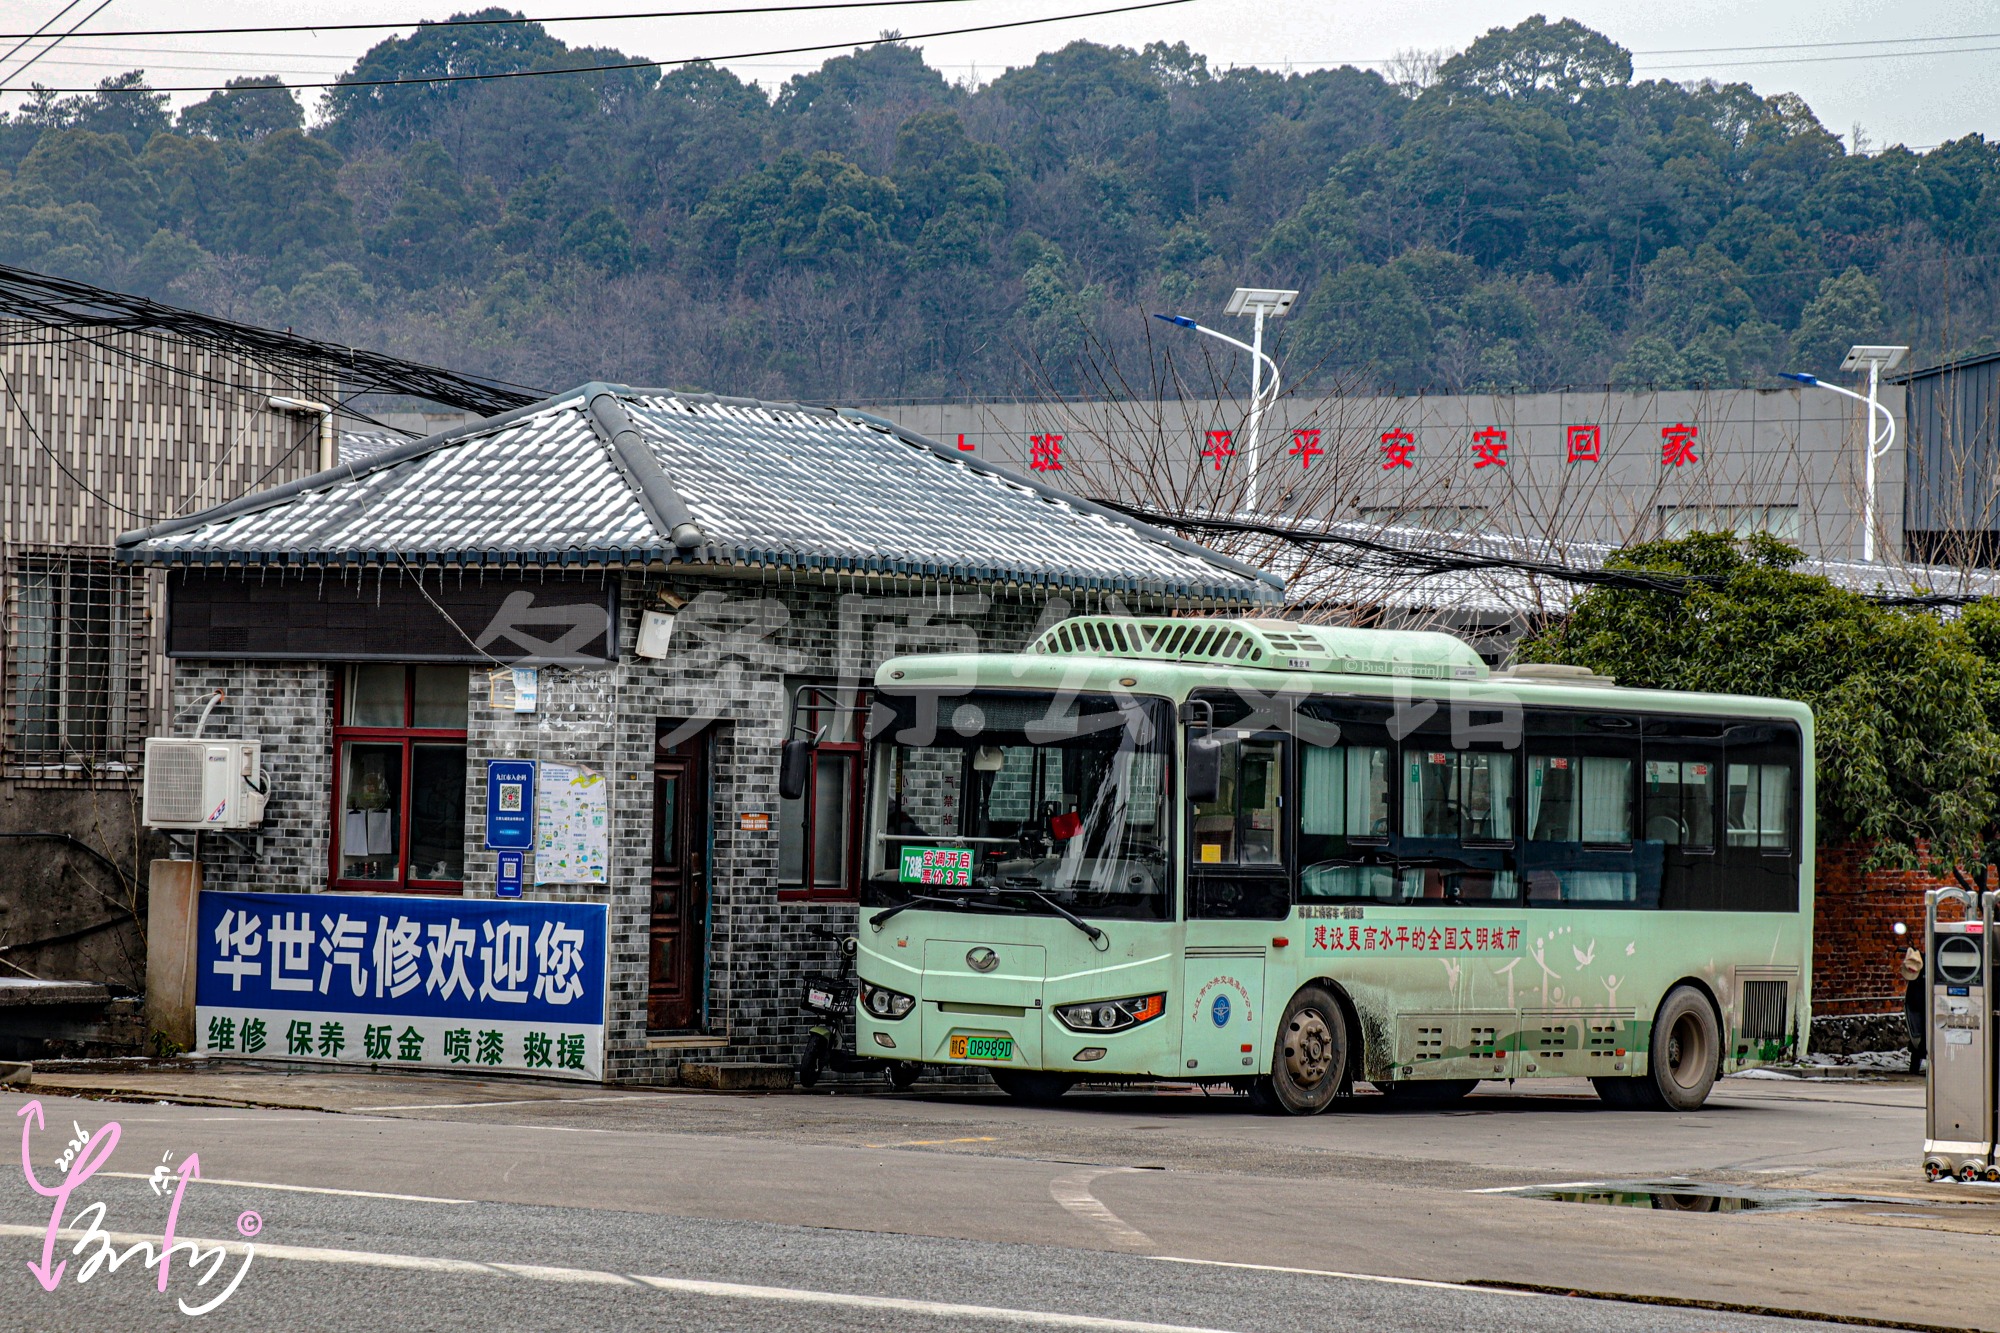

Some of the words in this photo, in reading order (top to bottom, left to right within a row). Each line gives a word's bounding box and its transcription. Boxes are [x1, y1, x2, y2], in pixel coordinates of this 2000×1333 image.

[1200, 423, 1700, 471] 平平安安回家
[496, 773, 527, 782] 九江市入企码
[923, 850, 971, 868] 空调开启
[921, 869, 969, 887] 票价3元
[1312, 924, 1520, 952] 建设更高水平的全国文明城市
[213, 908, 584, 1005] 华世汽修欢迎您
[207, 1015, 267, 1054] 维修
[286, 1020, 345, 1058] 保养
[364, 1023, 425, 1061] 钣金
[444, 1027, 505, 1066] 喷漆
[523, 1031, 586, 1070] 救援
